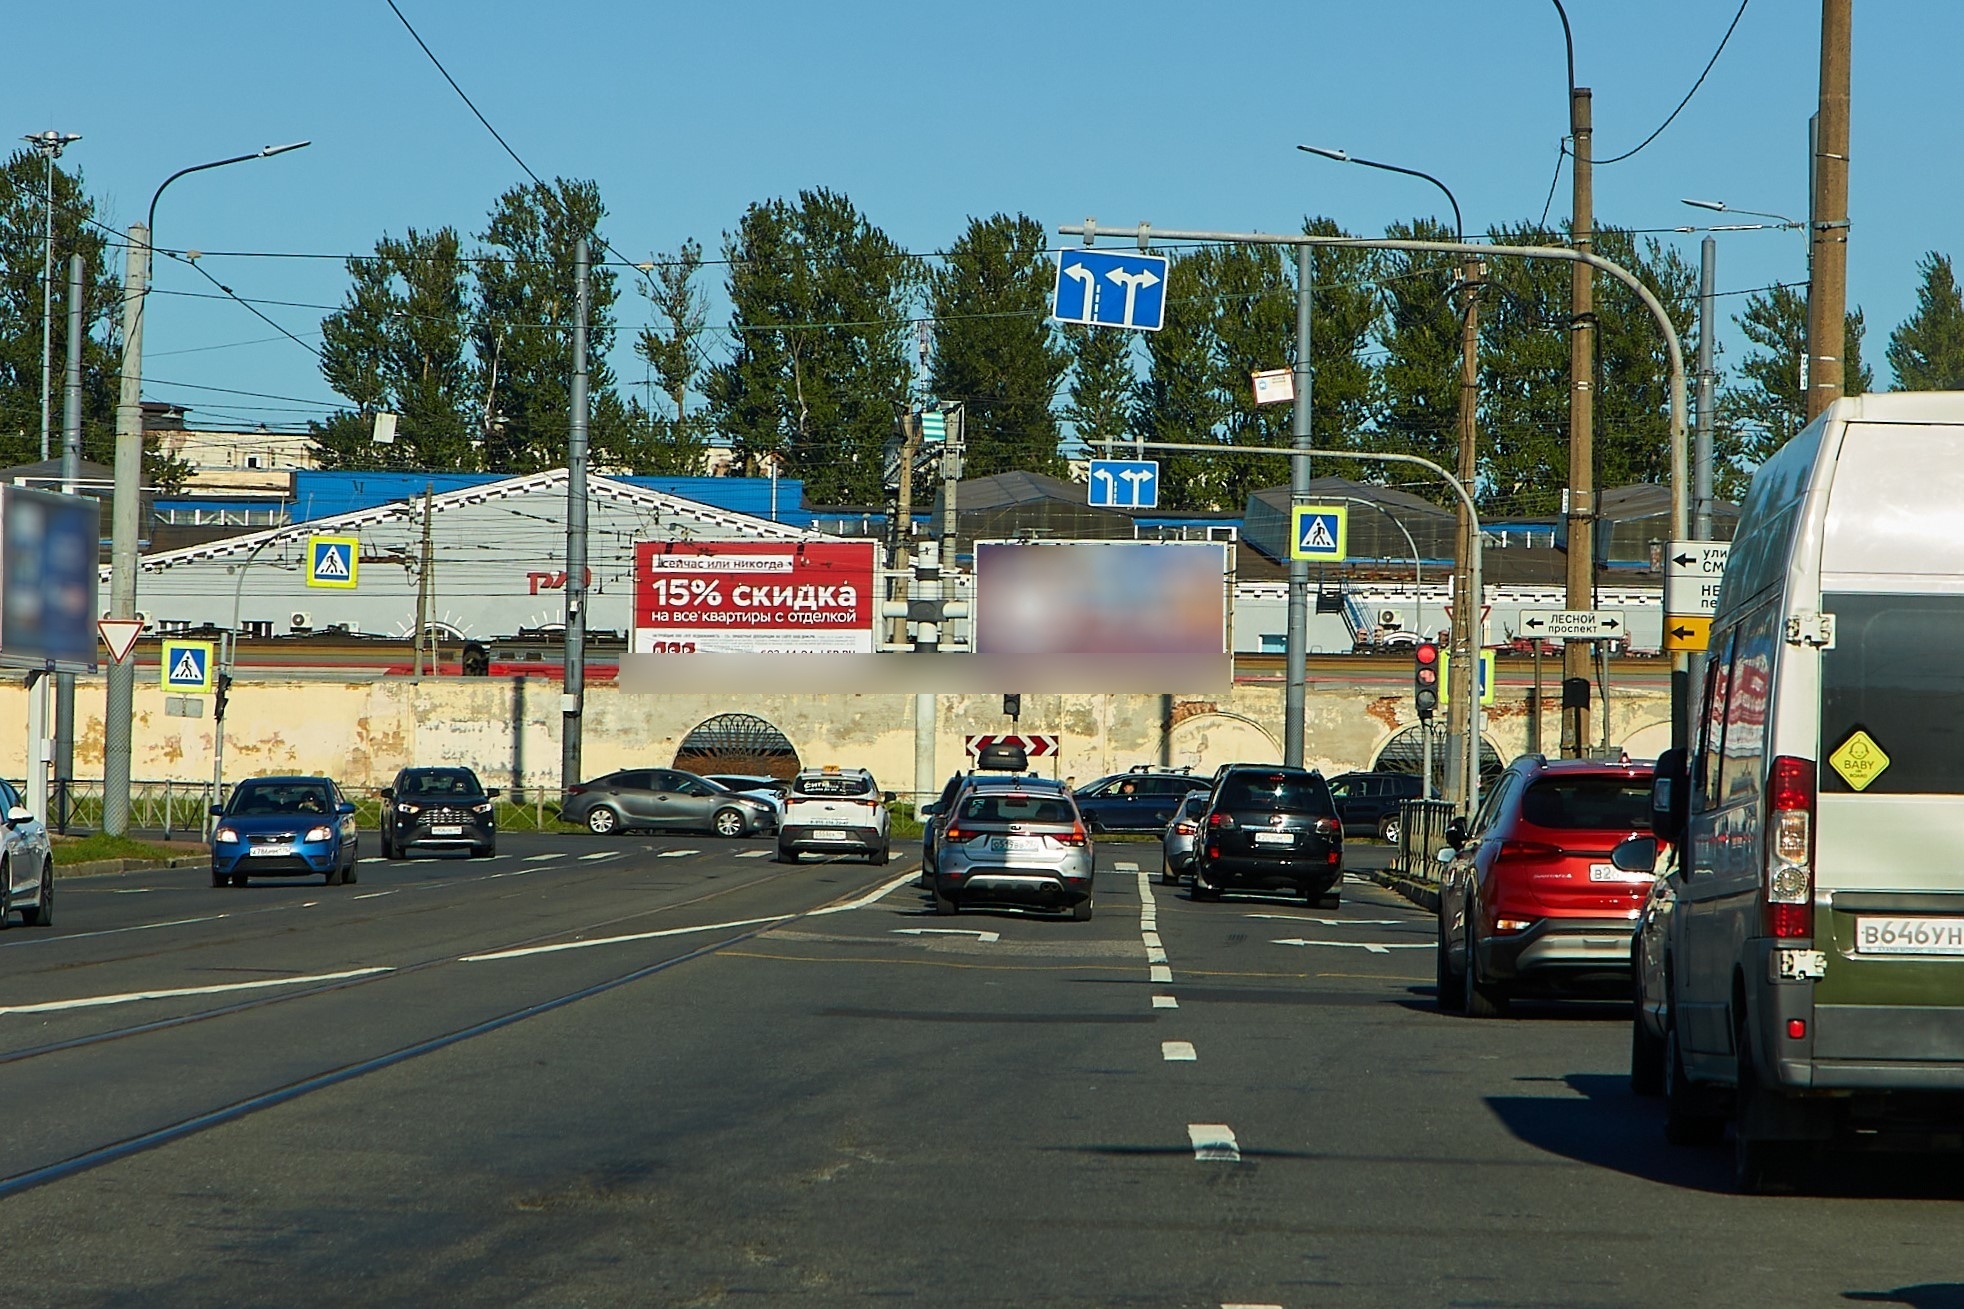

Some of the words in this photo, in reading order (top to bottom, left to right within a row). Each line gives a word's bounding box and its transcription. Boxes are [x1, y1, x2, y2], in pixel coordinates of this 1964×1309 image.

[1703, 549, 1728, 561] ули
[662, 559, 704, 569] сейчас
[707, 560, 731, 569] или
[733, 560, 784, 571] никогда
[1703, 561, 1725, 573] СМ
[652, 579, 723, 606] 15%
[732, 584, 857, 611] скидка
[1701, 585, 1721, 596] НЕ
[1701, 600, 1718, 608] пе
[651, 611, 670, 622] на
[702, 611, 771, 625] квартиры
[775, 612, 784, 622] с
[788, 609, 857, 624] отделкой
[1550, 613, 1596, 624] ЛЕСНОЙ
[1548, 625, 1597, 634] проспект
[1844, 760, 1875, 770] BABY
[1865, 921, 1962, 945] В646УН
